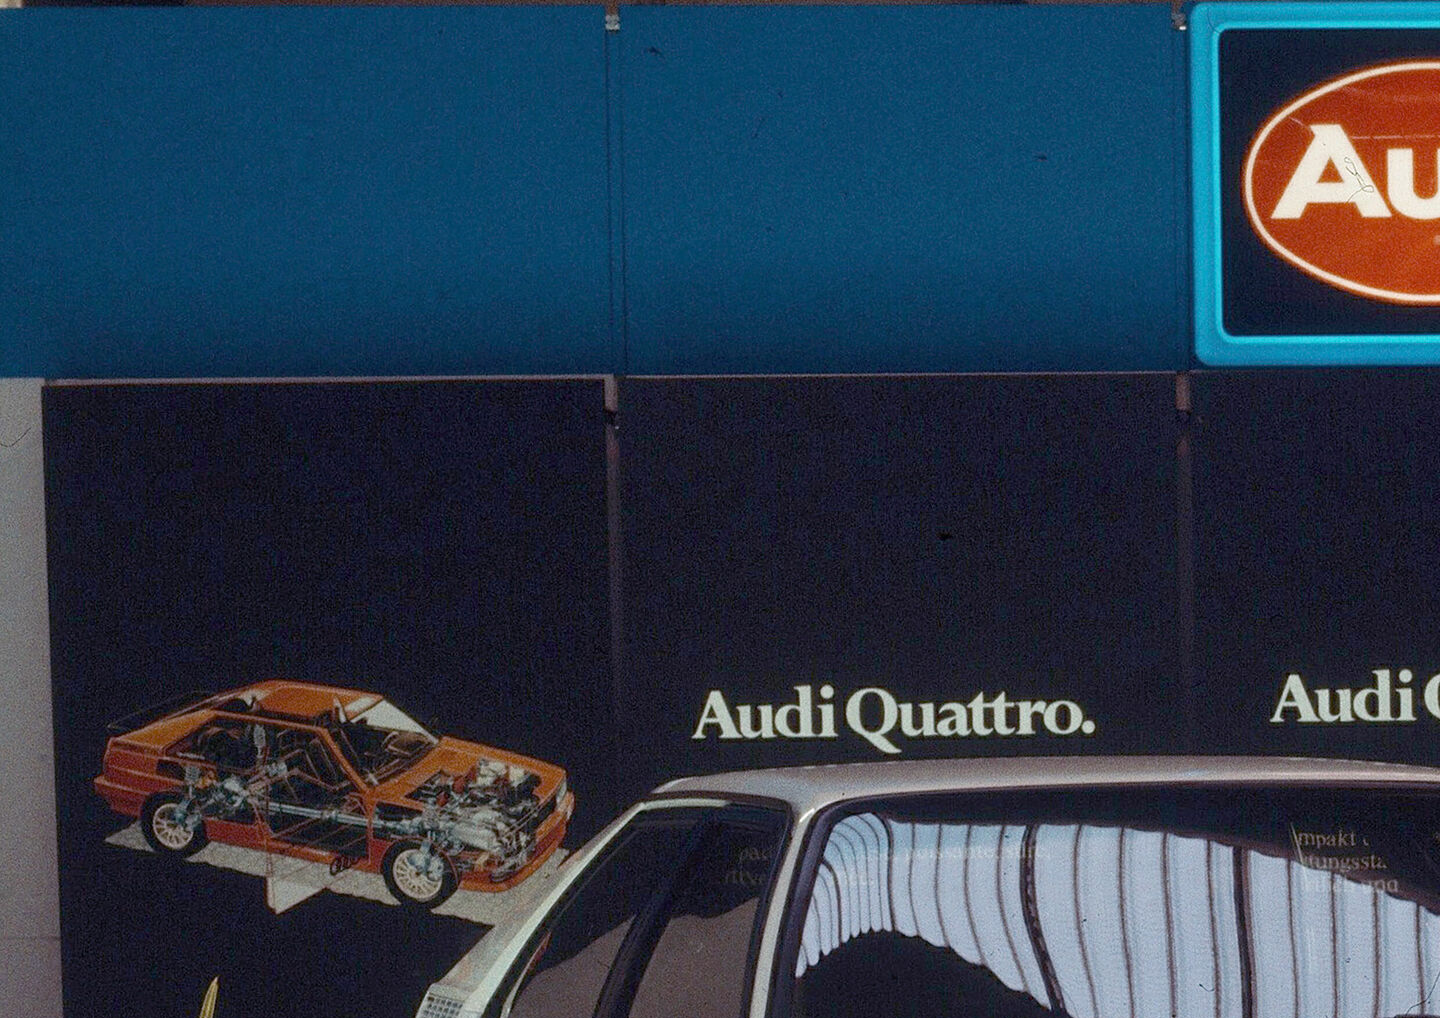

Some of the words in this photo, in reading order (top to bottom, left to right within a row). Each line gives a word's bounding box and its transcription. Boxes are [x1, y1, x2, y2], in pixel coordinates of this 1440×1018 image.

[691, 685, 839, 739] Audi
[845, 687, 1097, 754] Quattro.
[1271, 669, 1417, 723] Audi
